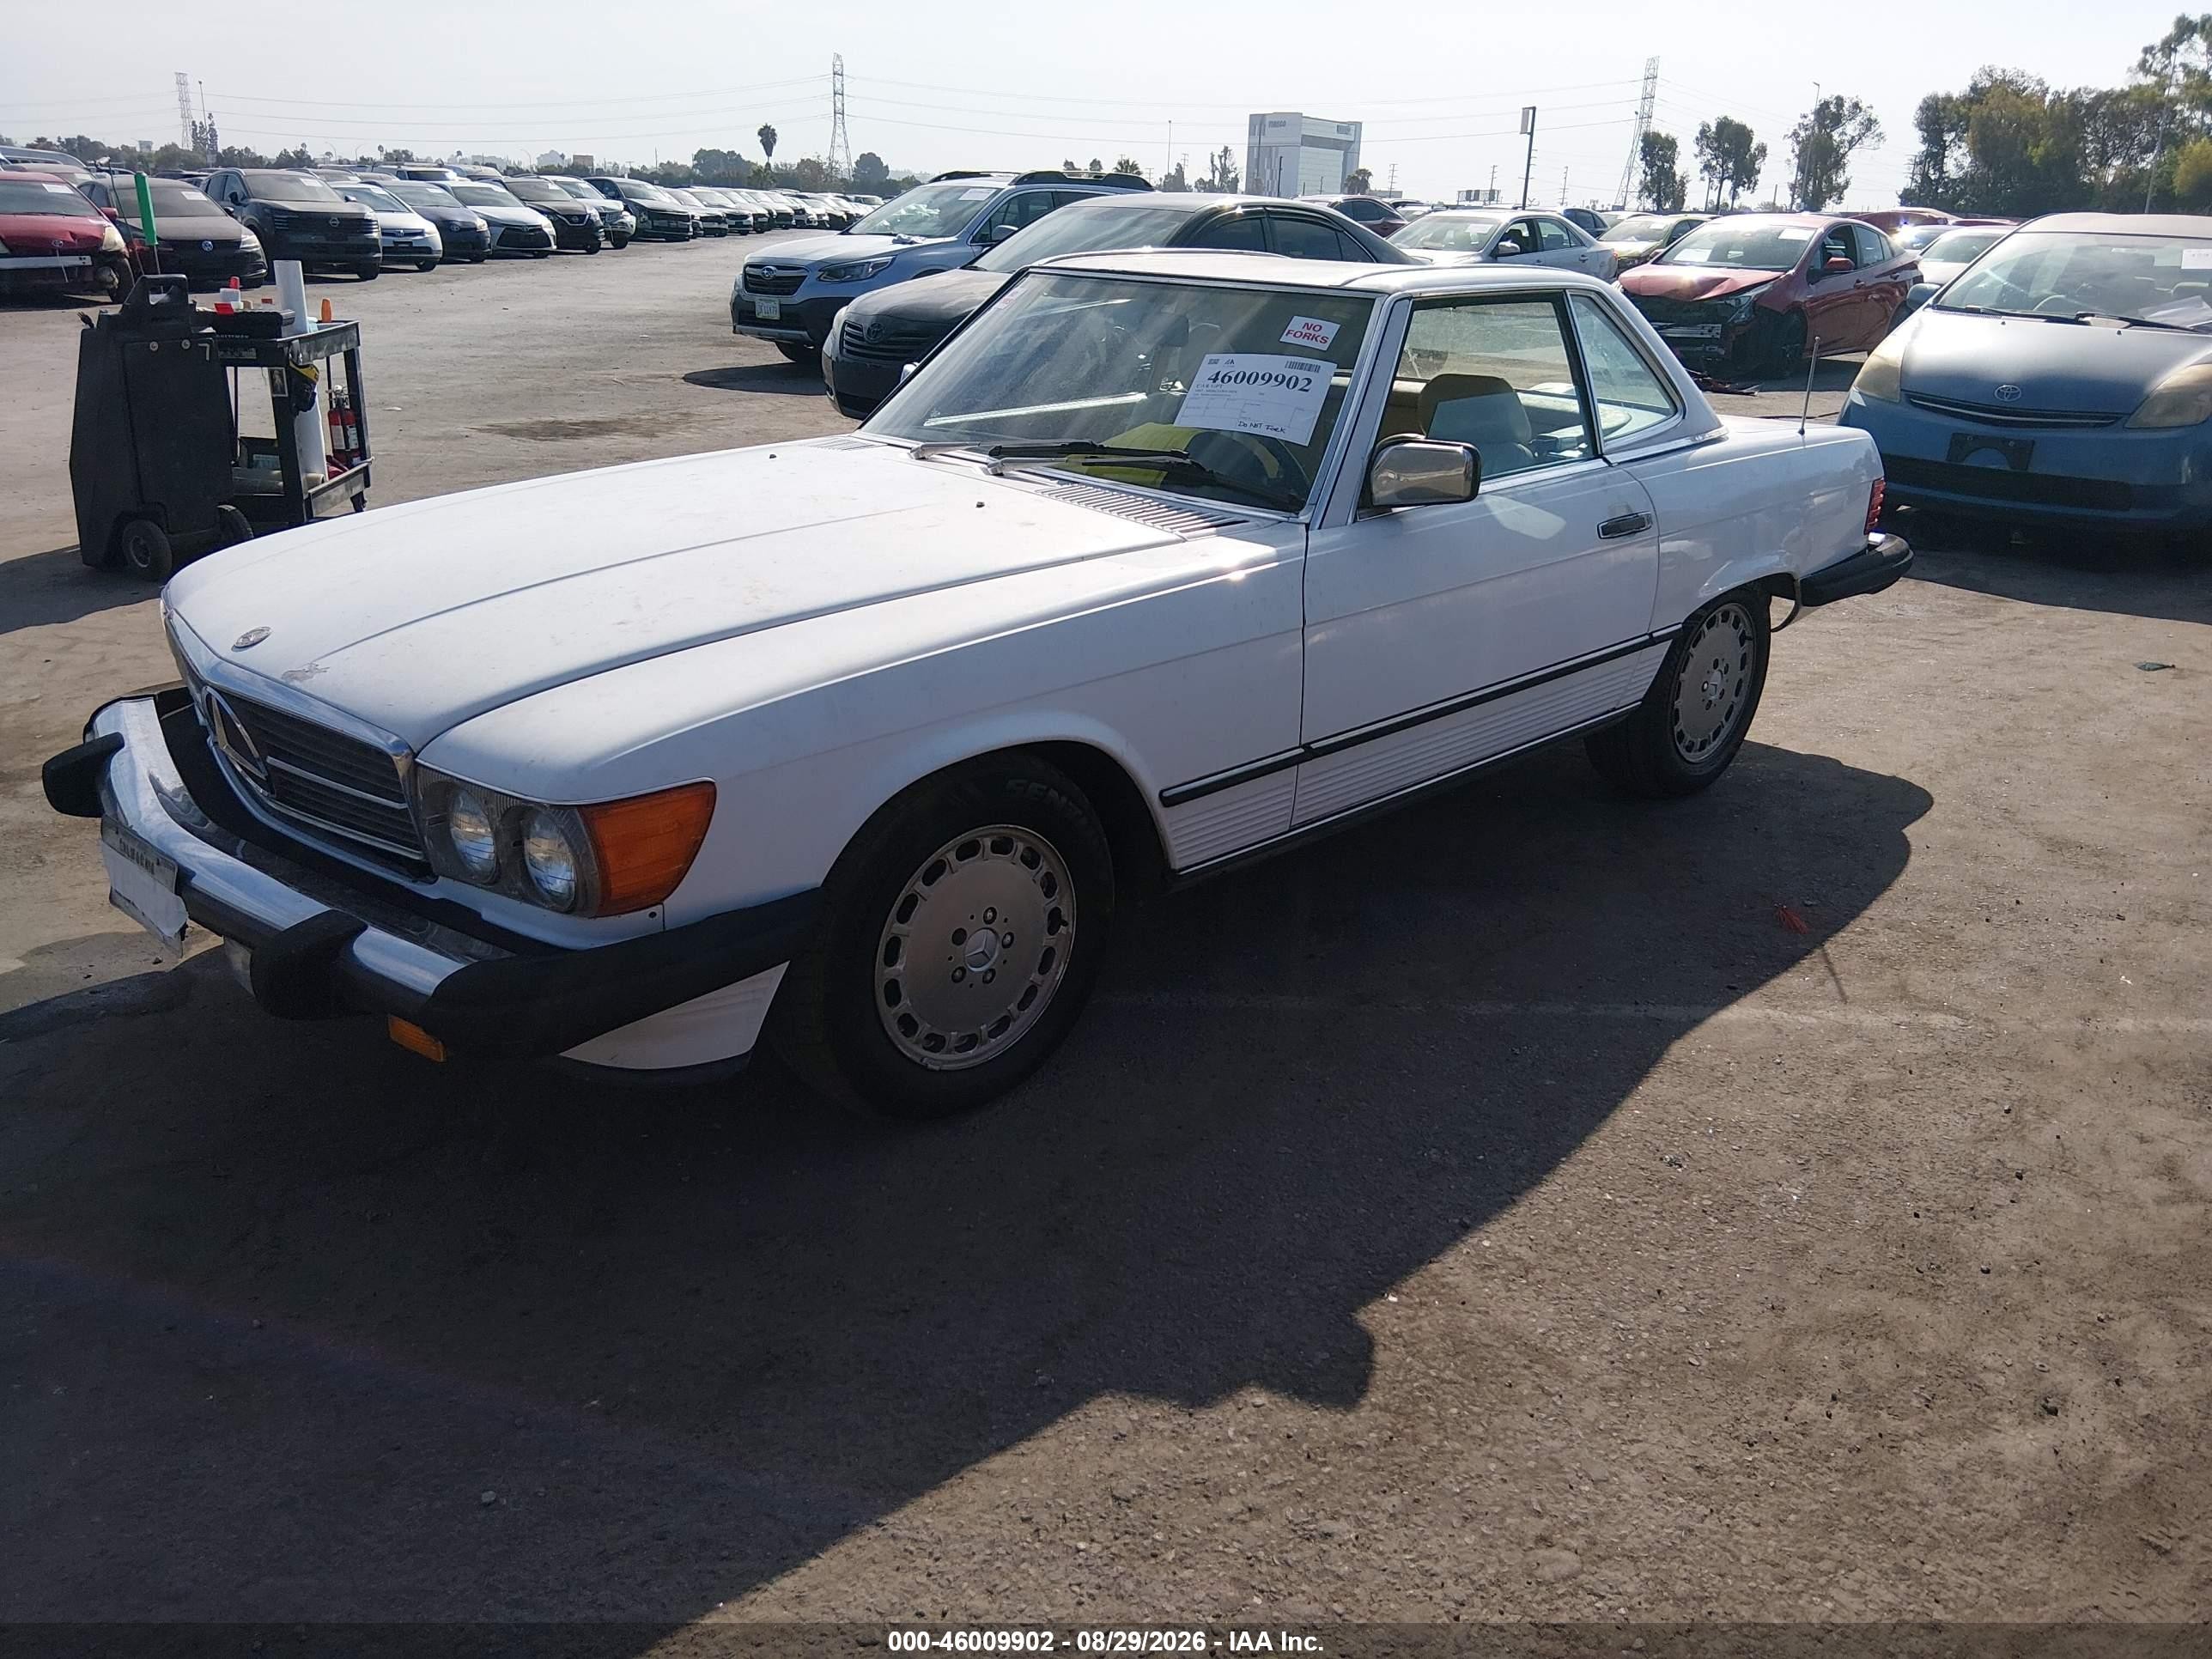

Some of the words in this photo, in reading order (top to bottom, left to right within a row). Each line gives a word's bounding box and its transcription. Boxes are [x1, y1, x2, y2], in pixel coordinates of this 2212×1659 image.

[1302, 322, 1322, 332] NO
[1285, 329, 1329, 344] FORKS
[1207, 371, 1312, 392] 46009902
